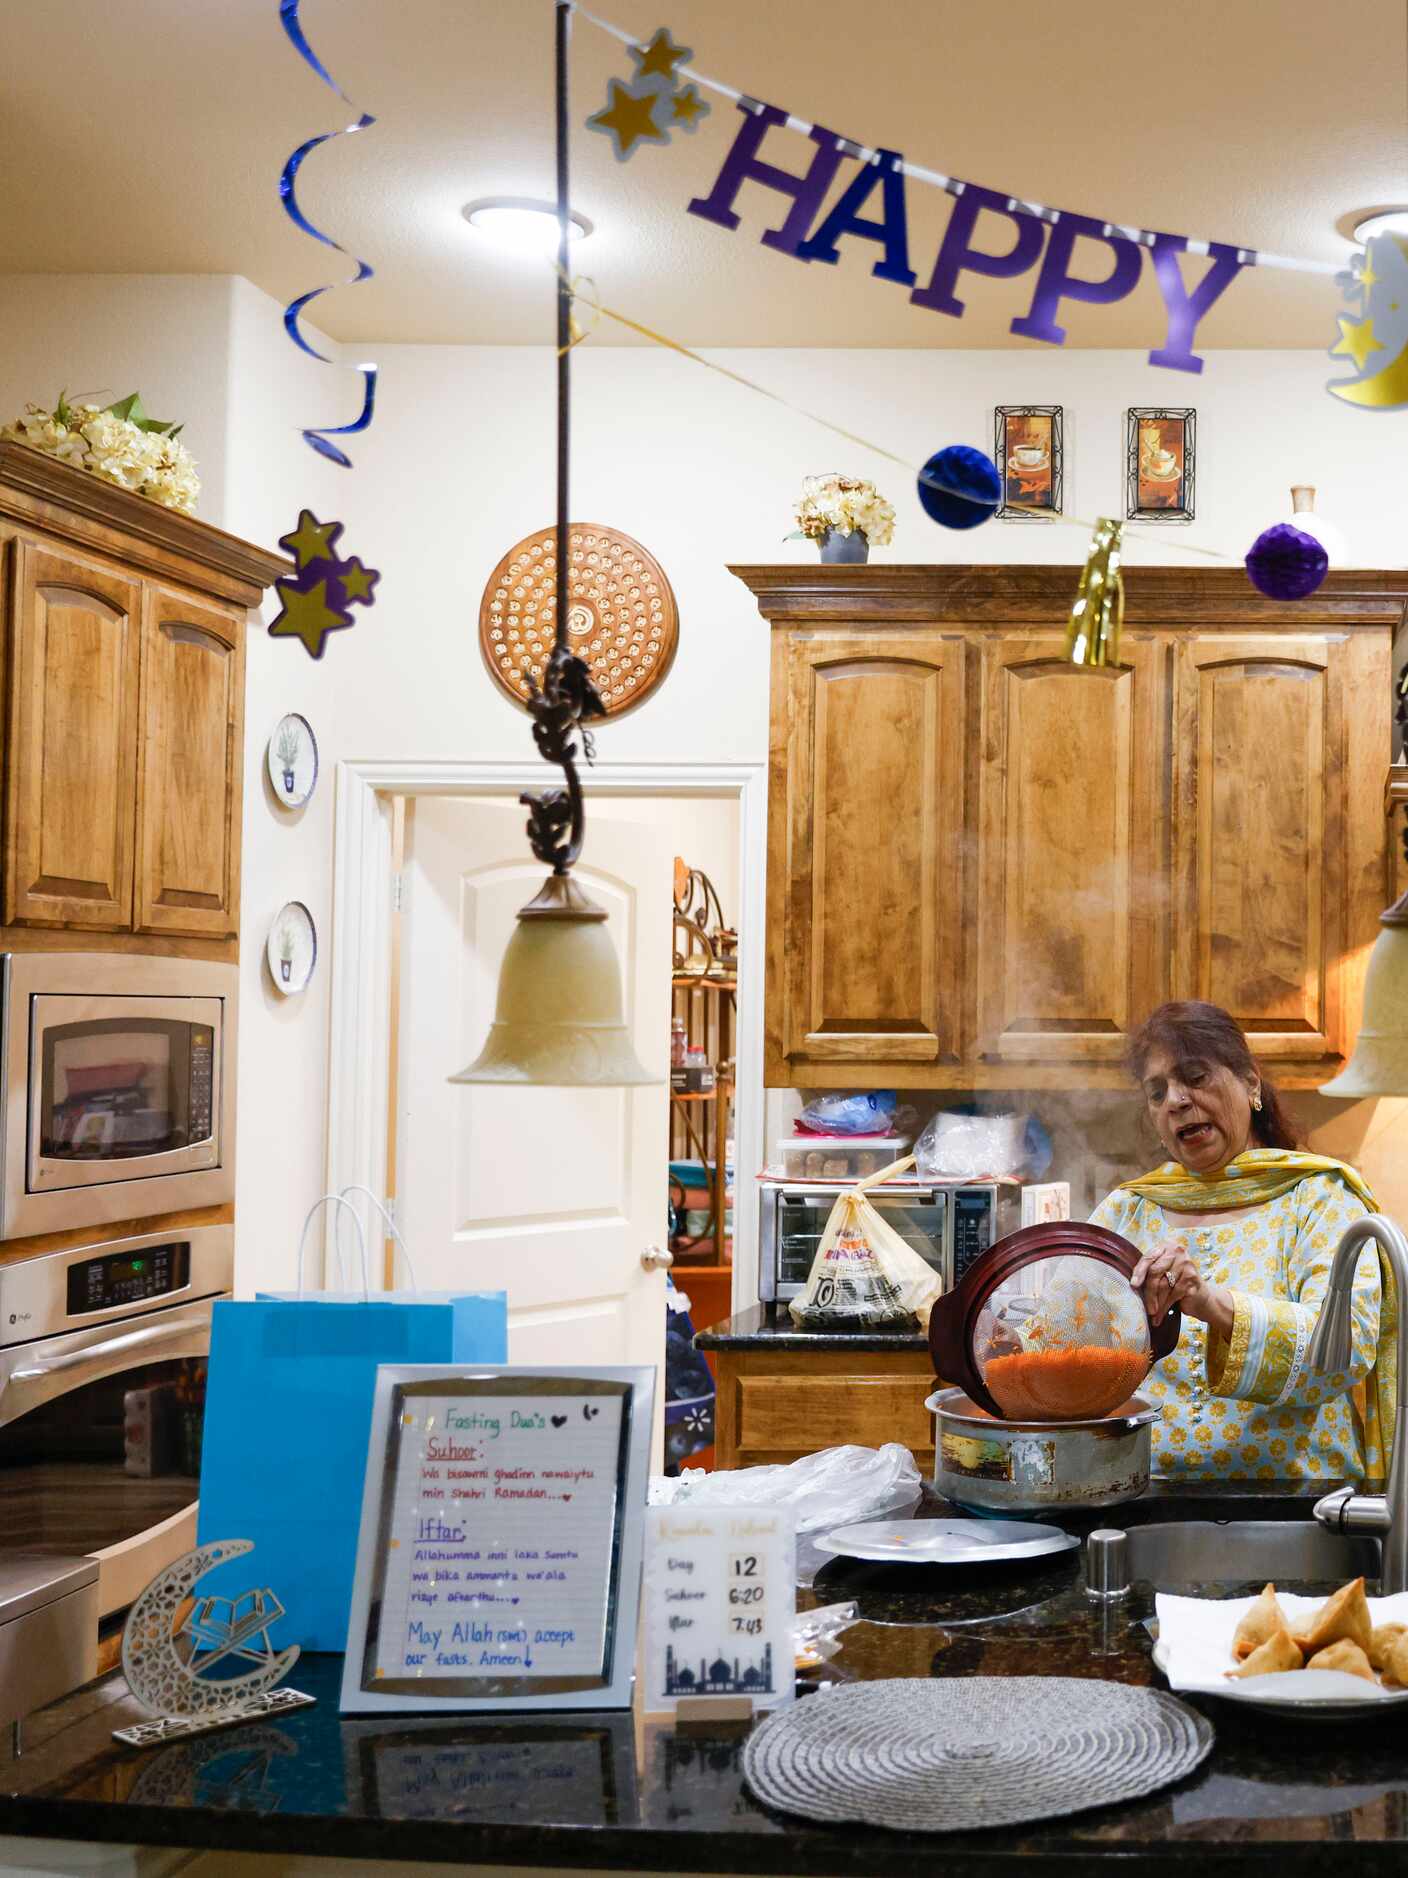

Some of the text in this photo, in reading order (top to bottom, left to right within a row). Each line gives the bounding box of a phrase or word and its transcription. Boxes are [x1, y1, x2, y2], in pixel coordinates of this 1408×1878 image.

[687, 95, 1256, 375] HAPPY
[446, 1408, 500, 1438] Fasting
[667, 1556, 758, 1577] Day 12
[408, 1621, 442, 1650] May
[451, 1620, 493, 1642] Allah
[534, 1629, 576, 1648] accept
